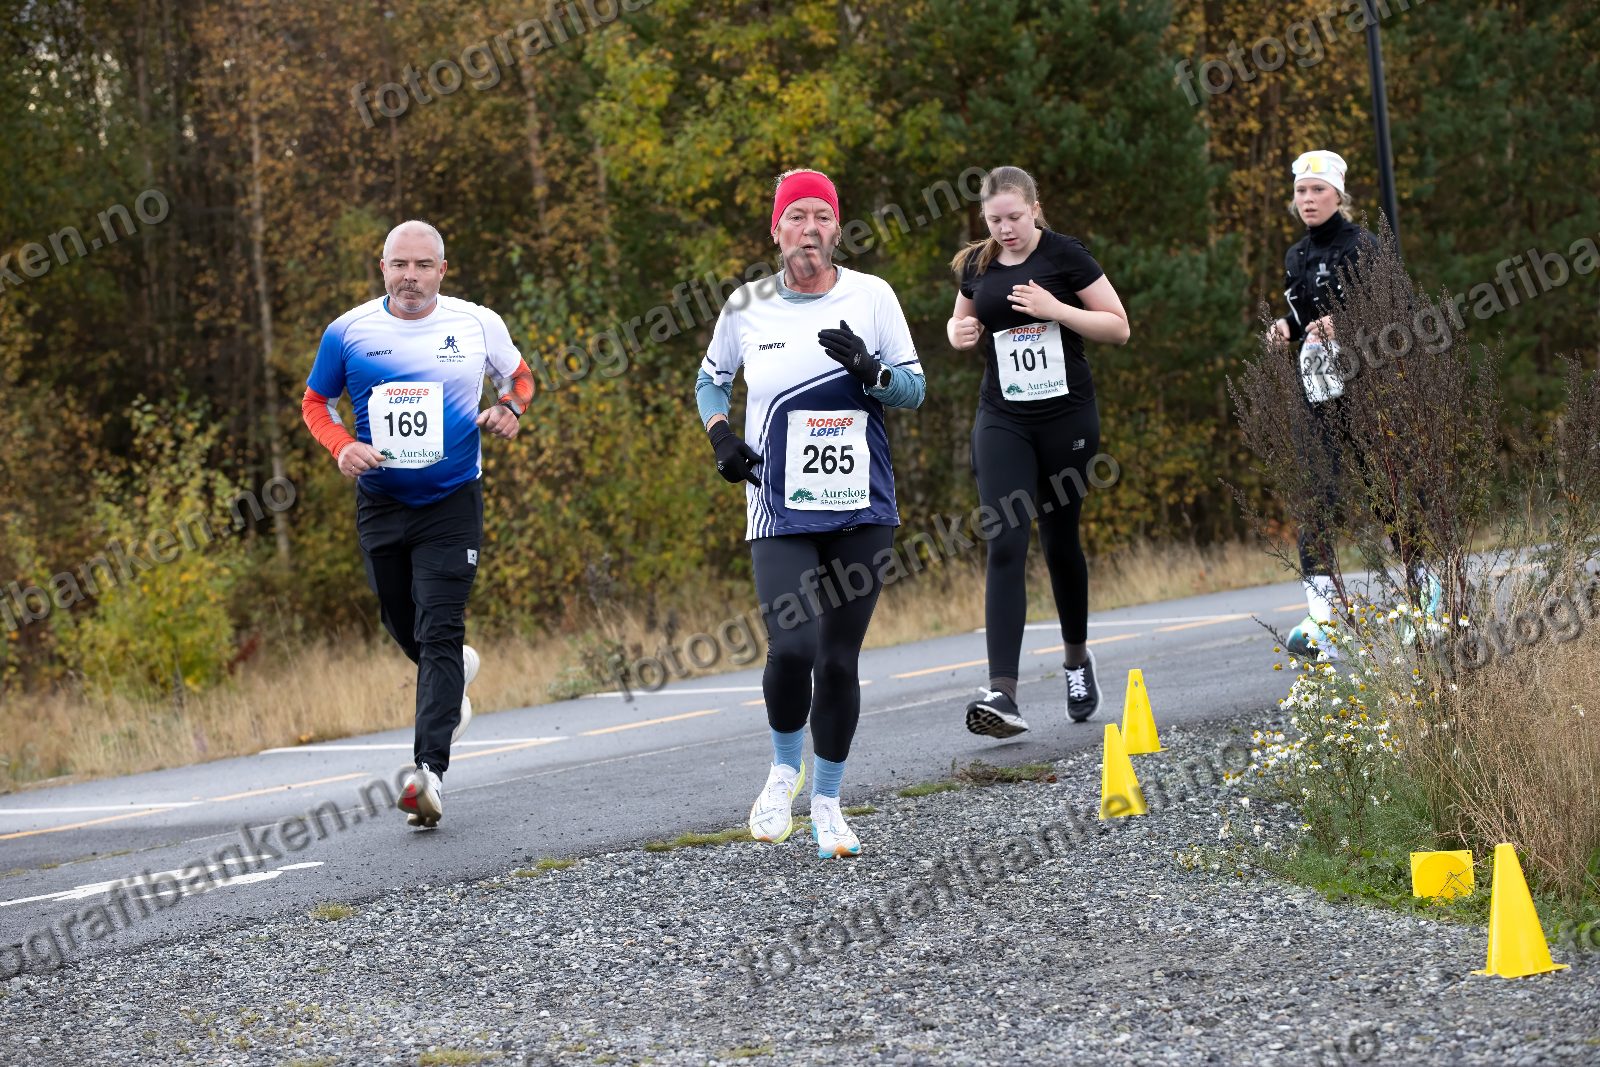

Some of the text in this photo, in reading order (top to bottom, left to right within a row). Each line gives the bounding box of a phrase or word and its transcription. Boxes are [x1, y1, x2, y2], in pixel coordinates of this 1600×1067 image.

[1008, 325, 1048, 335] NORGES
[1013, 334, 1041, 342] LØPET
[758, 342, 786, 351] TRIMTEX
[365, 349, 393, 358] TRIMTEX
[1009, 346, 1048, 372] 101
[1027, 380, 1064, 390] Aurskog
[385, 388, 430, 396] NORGES
[388, 395, 422, 404] LØPET
[384, 410, 428, 438] 169
[806, 417, 854, 428] NORGES
[809, 427, 847, 437] LØPET
[399, 448, 441, 460] Aurskog
[802, 444, 855, 475] 265
[820, 488, 867, 499] Aurskog
